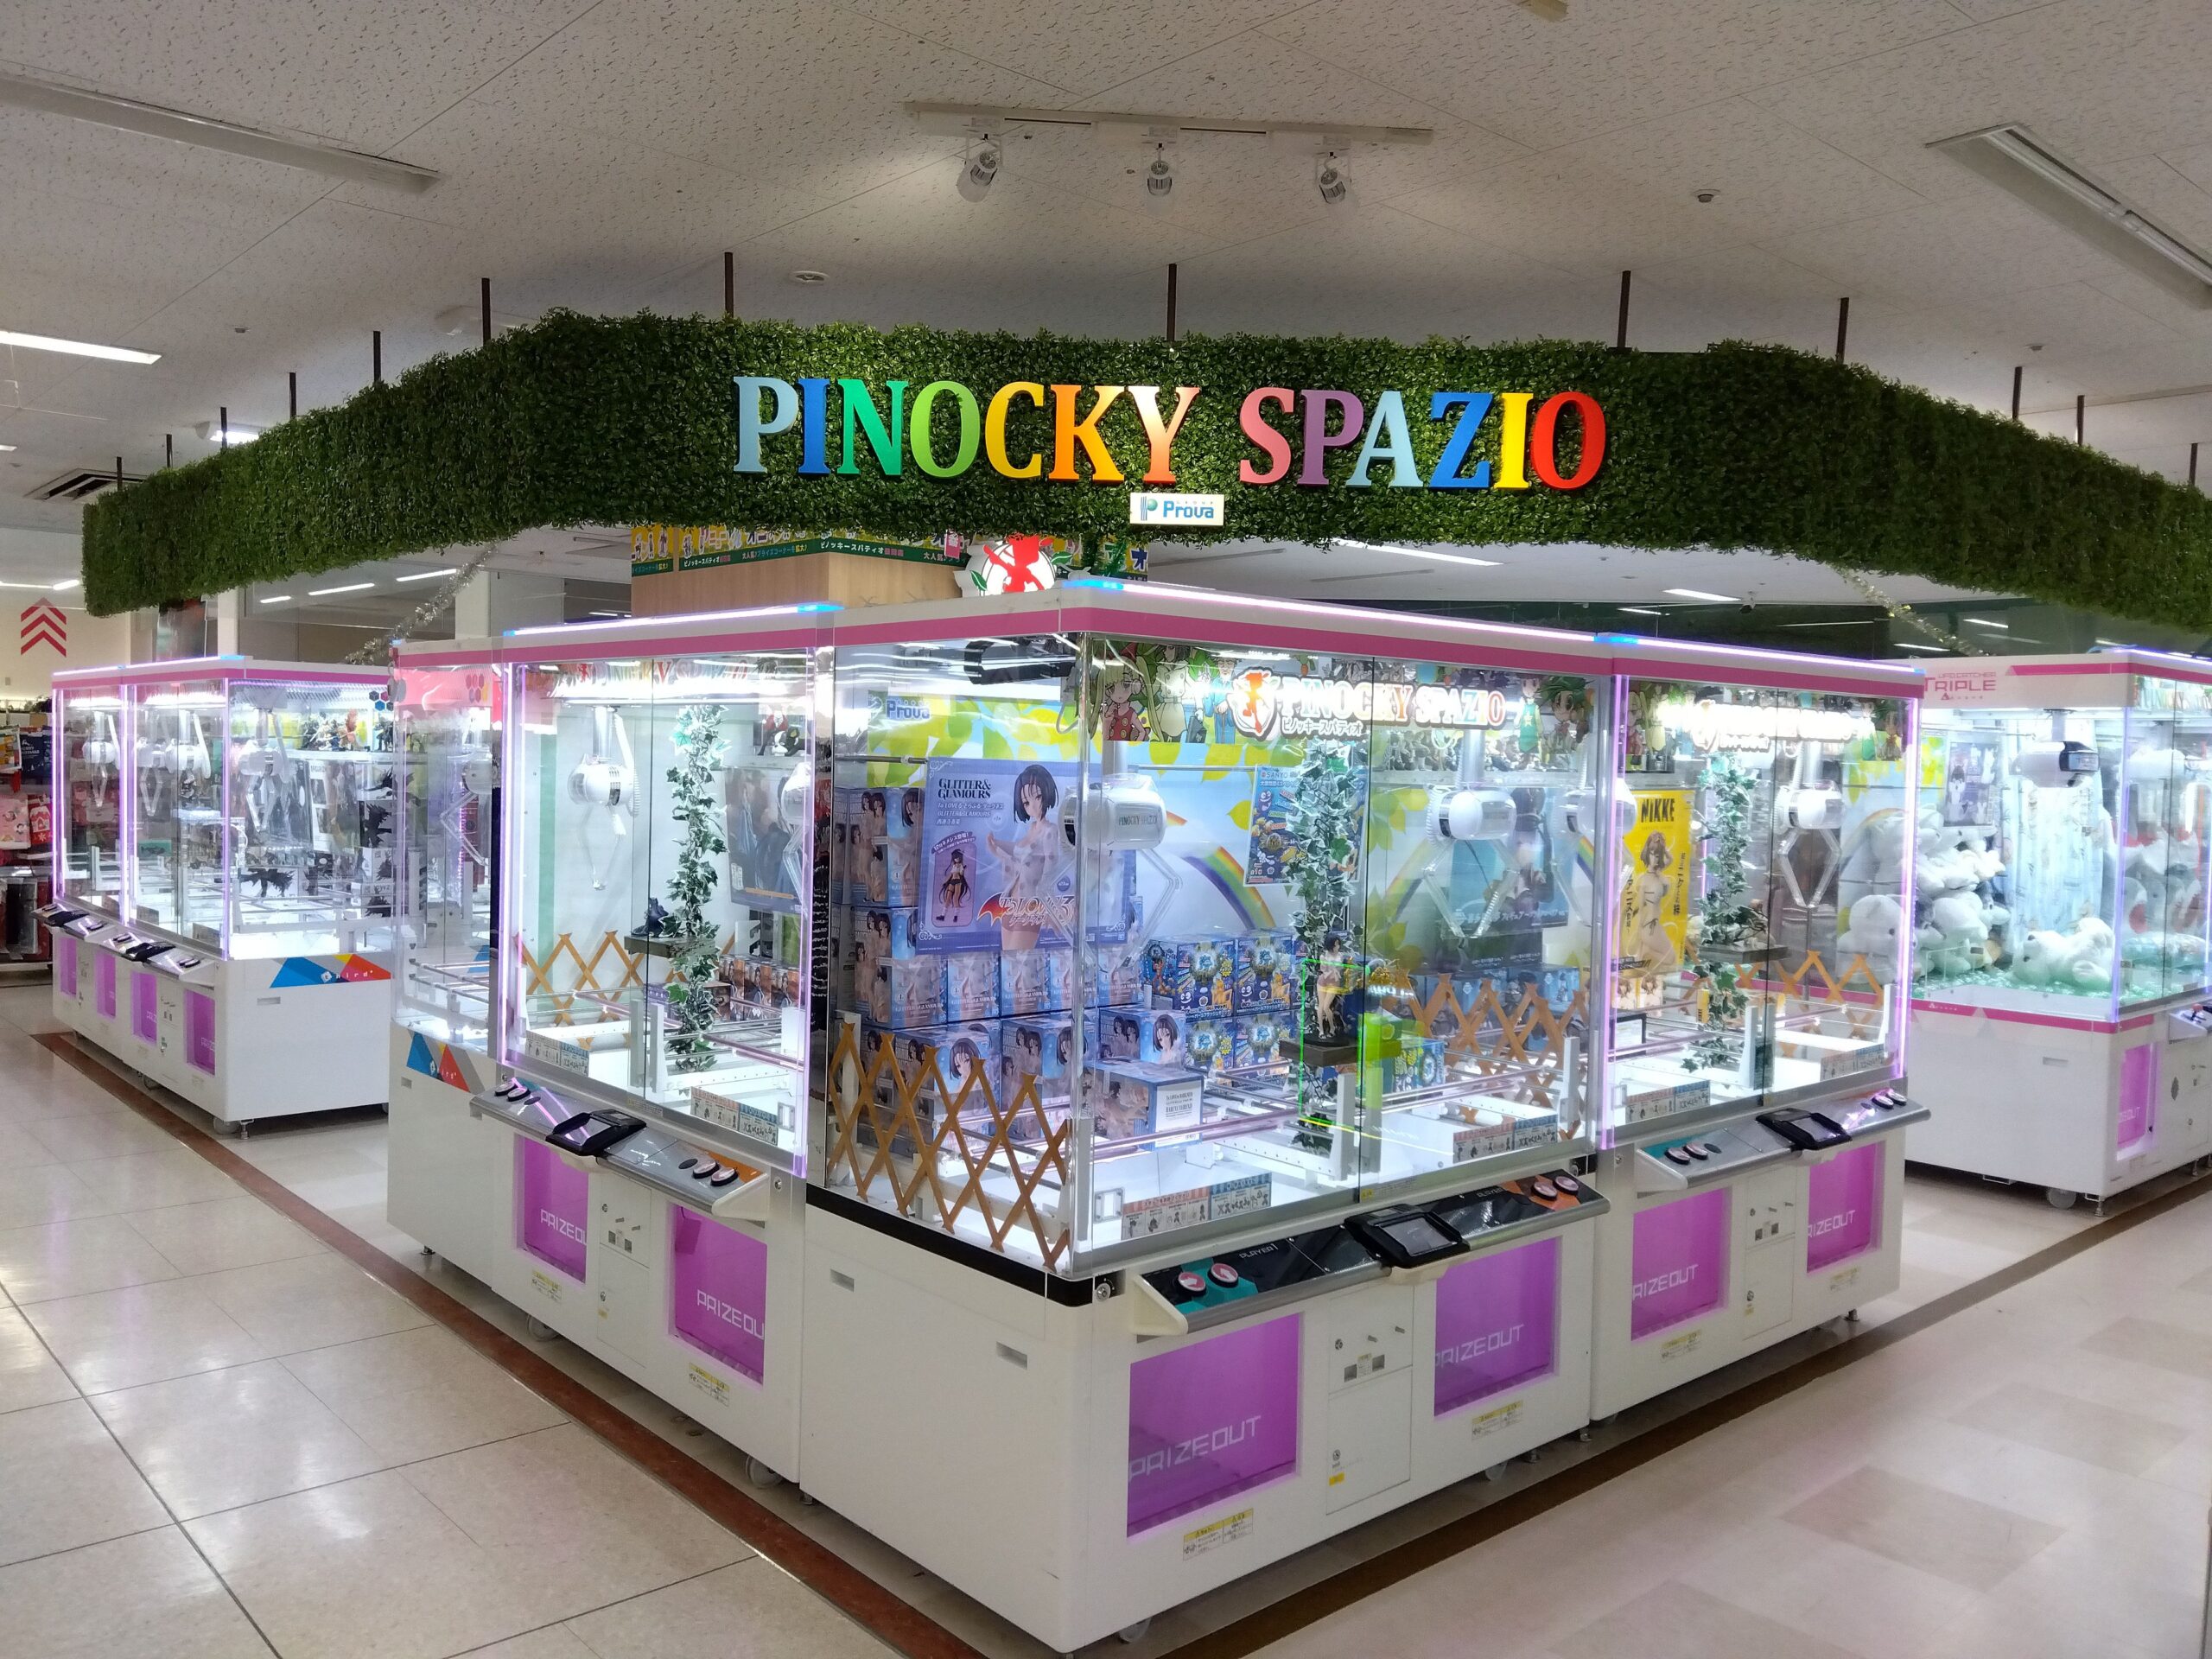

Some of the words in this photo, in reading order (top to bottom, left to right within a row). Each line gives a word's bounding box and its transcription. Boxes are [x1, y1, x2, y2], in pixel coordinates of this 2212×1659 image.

[733, 376, 1200, 484] PINOCKY
[1239, 386, 1607, 491] SPAZIO
[1162, 500, 1215, 518] Prova
[1924, 677, 1997, 691] TRIPLE
[1282, 677, 1413, 721] PINOCKY
[1415, 685, 1507, 726] SPAZIO
[938, 779, 991, 790] GLITTER&
[938, 789, 991, 799] GLAMOURS
[1641, 798, 1675, 823] NIKKE
[1129, 1414, 1262, 1483] PRIZEOUT
